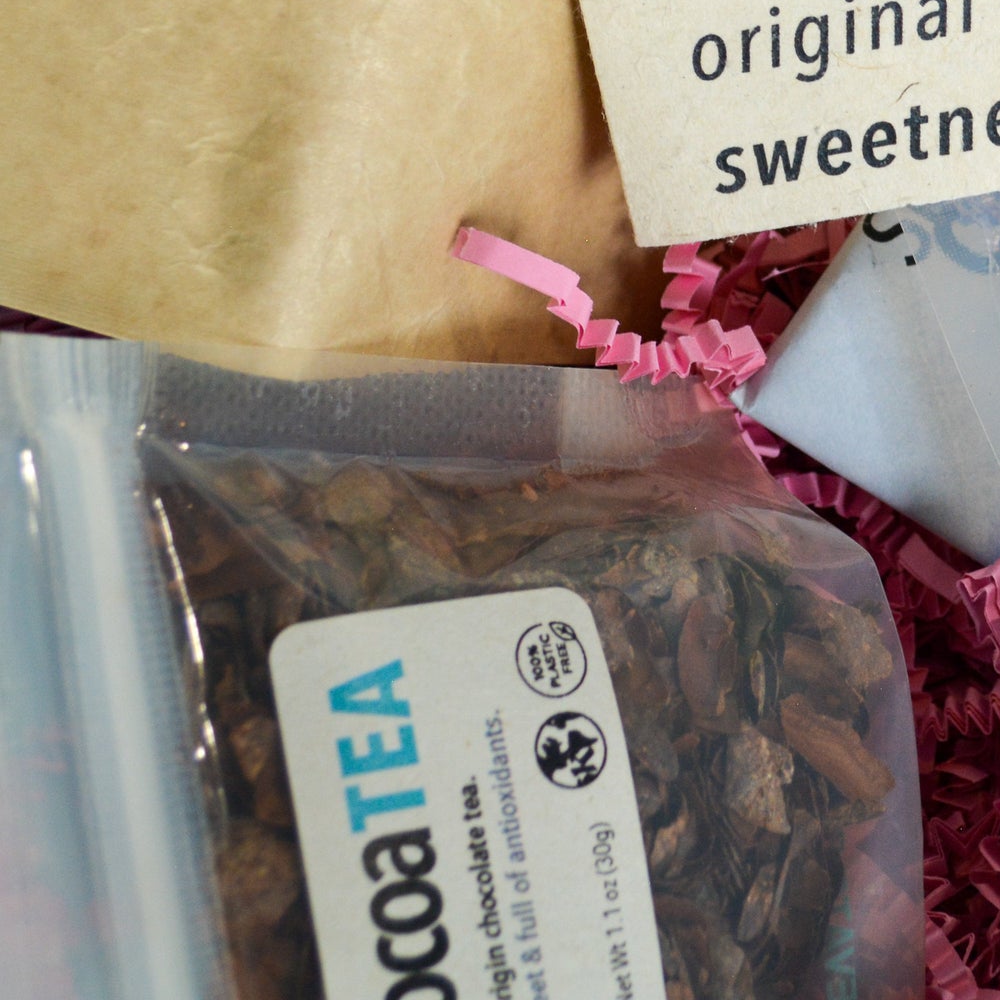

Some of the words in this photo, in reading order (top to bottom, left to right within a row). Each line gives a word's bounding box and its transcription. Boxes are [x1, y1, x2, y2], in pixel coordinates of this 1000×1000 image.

[556, 641, 573, 675] FREE
[462, 775, 483, 821] tea.
[589, 821, 619, 876] (30g)
[467, 826, 502, 939] chocolate
[505, 870, 531, 893] of
[604, 879, 619, 901] oz
[510, 900, 539, 941] full
[520, 946, 542, 963] &
[610, 941, 629, 972] Wt
